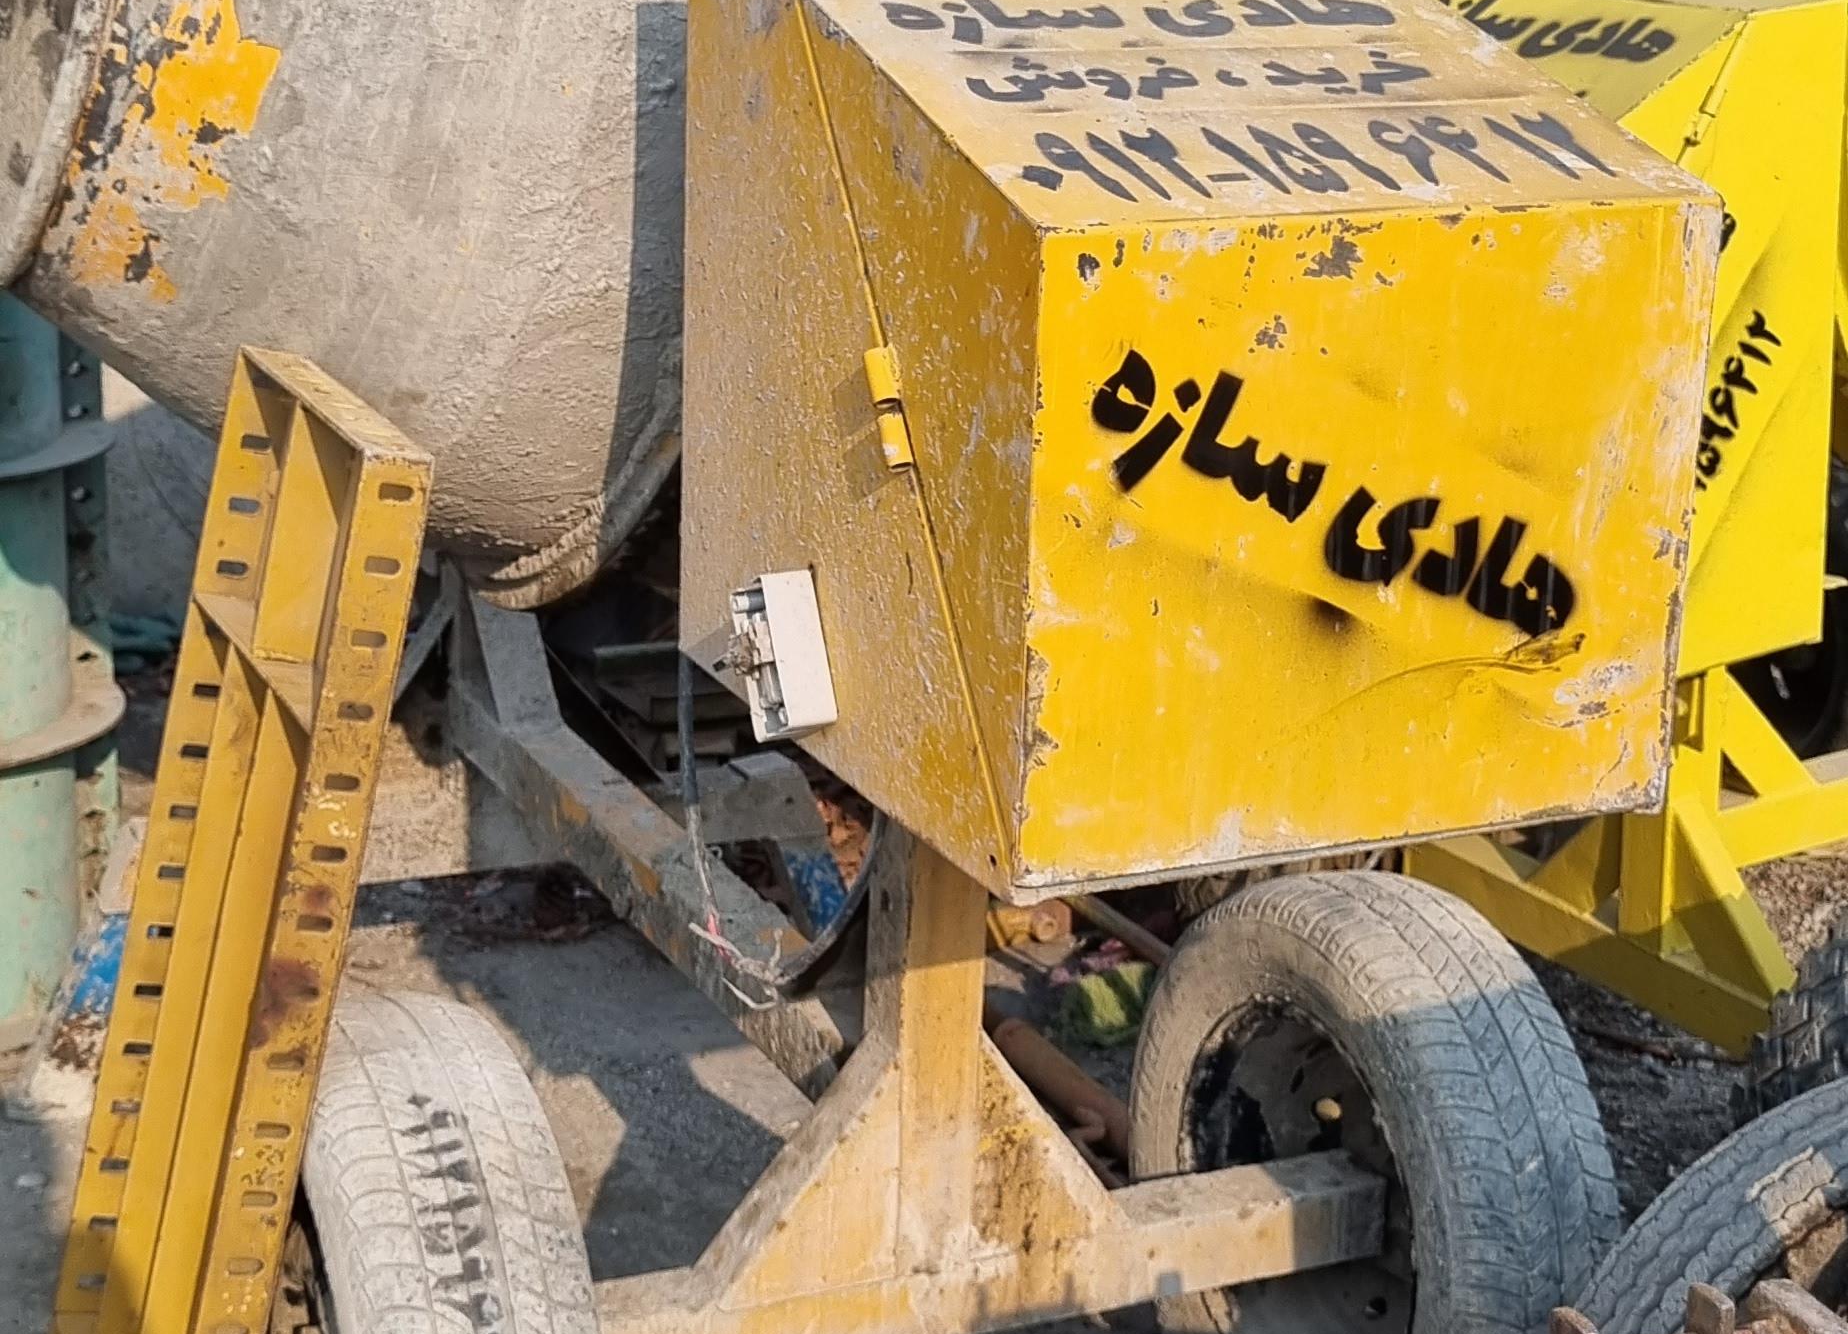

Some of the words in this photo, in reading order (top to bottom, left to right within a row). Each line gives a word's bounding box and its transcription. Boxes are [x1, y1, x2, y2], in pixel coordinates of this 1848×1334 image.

[966, 56, 1199, 102] فروش
[1516, 18, 1675, 62] هادی
[1090, 349, 1326, 523] سازه
[1324, 487, 1575, 638] هادی
